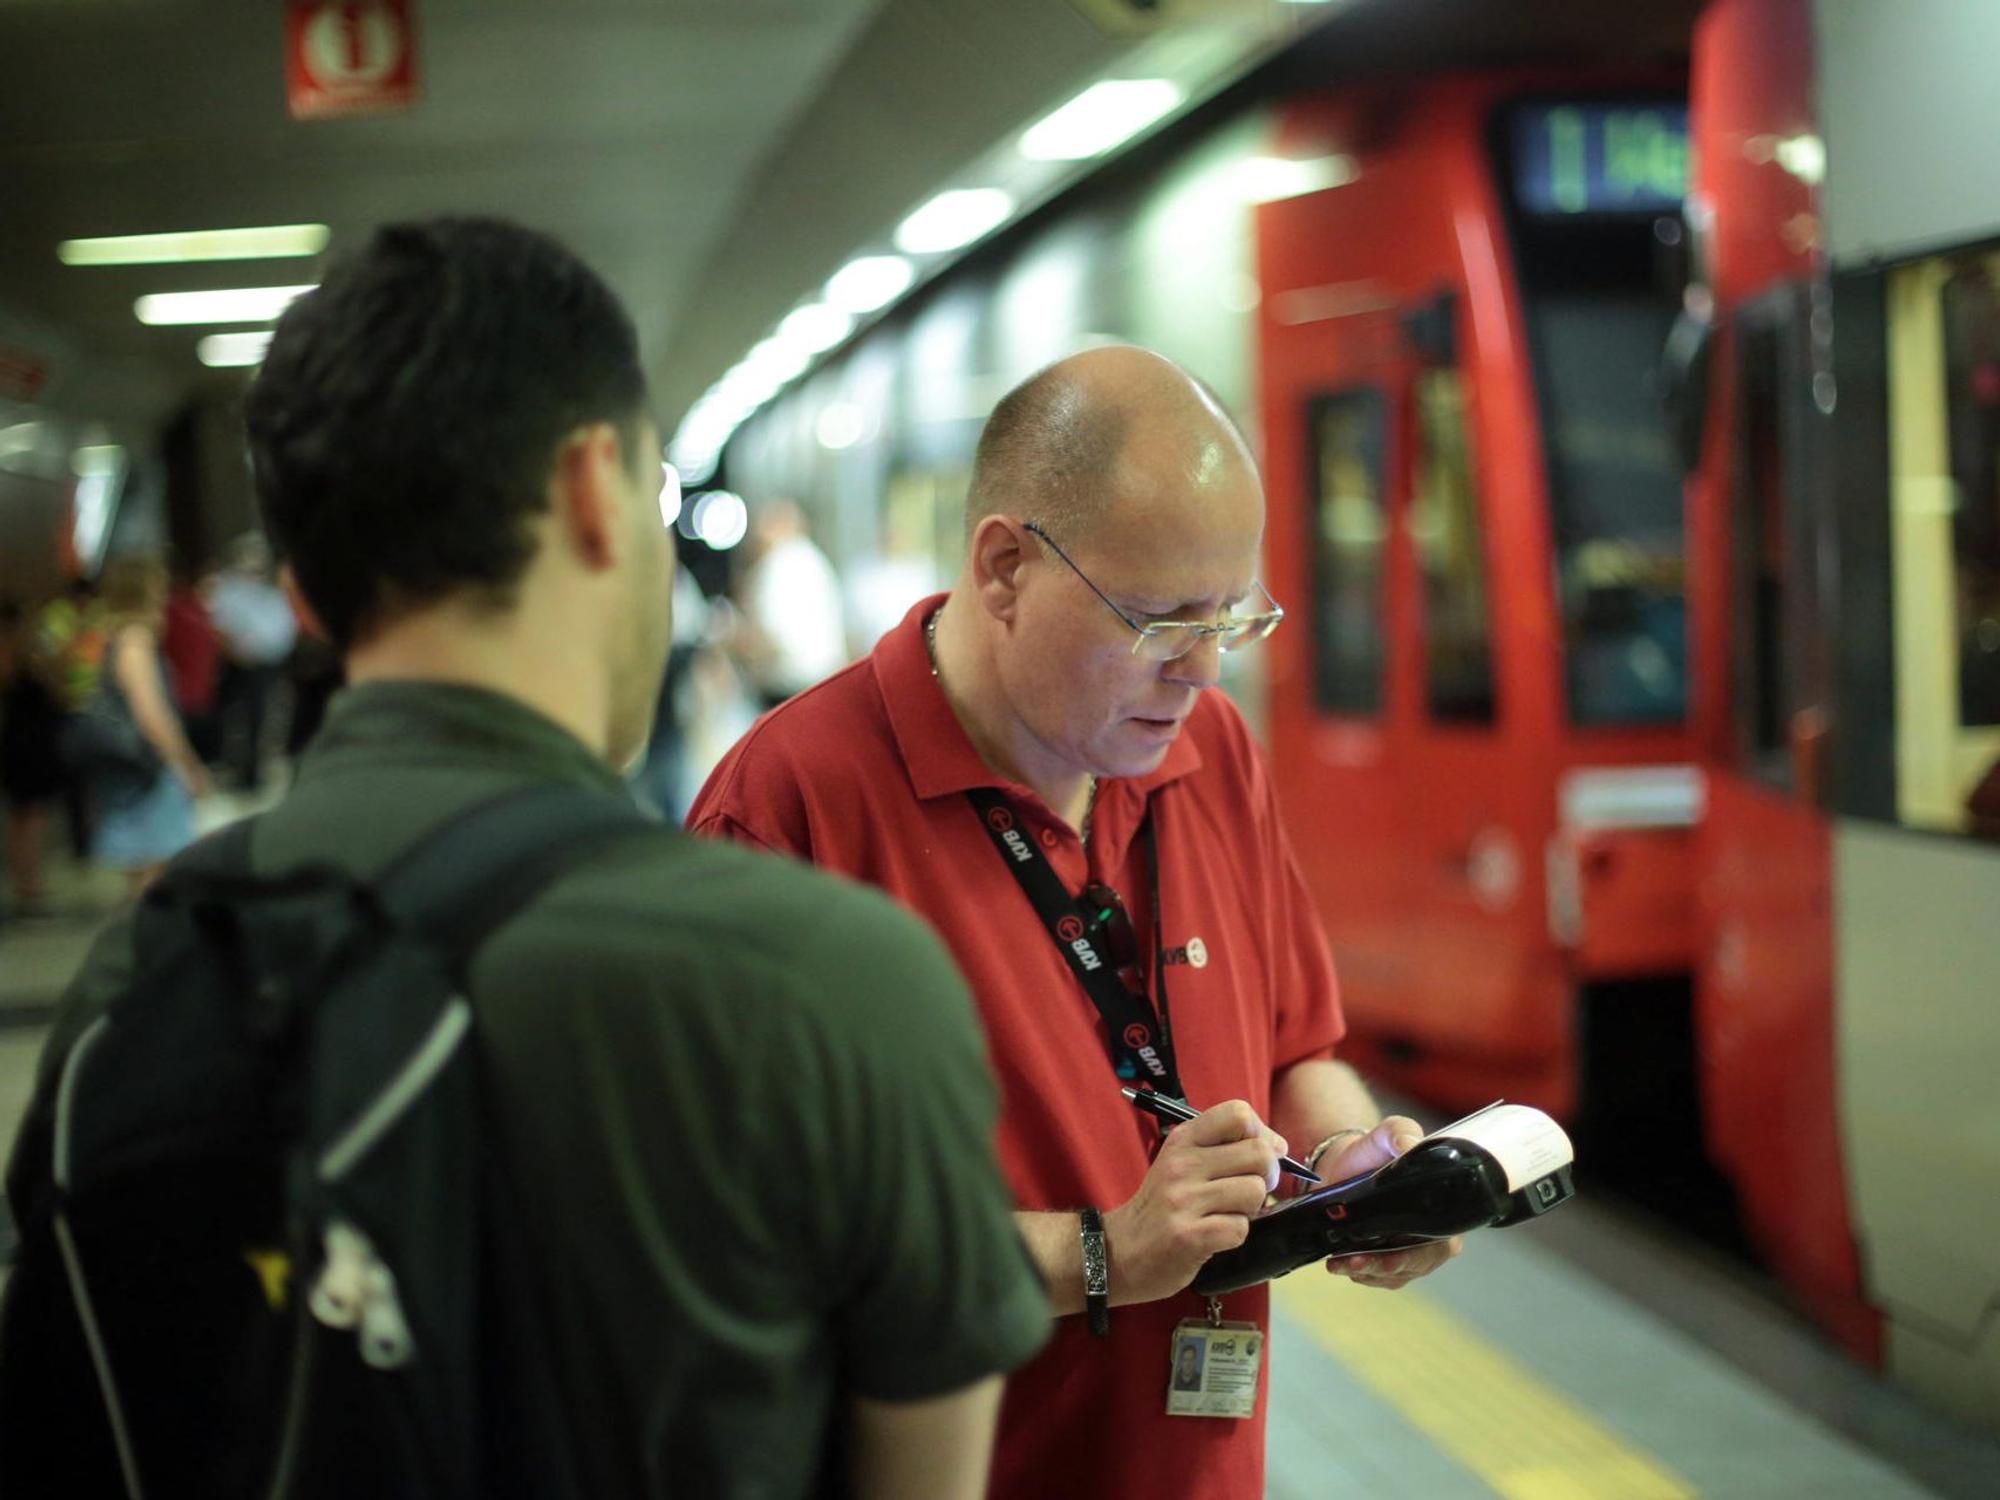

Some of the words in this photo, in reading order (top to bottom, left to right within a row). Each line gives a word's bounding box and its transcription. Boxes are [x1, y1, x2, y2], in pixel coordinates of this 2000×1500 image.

[1003, 830, 1032, 862] KVB
[1072, 938, 1101, 971] KVB
[1138, 1046, 1166, 1076] KVB
